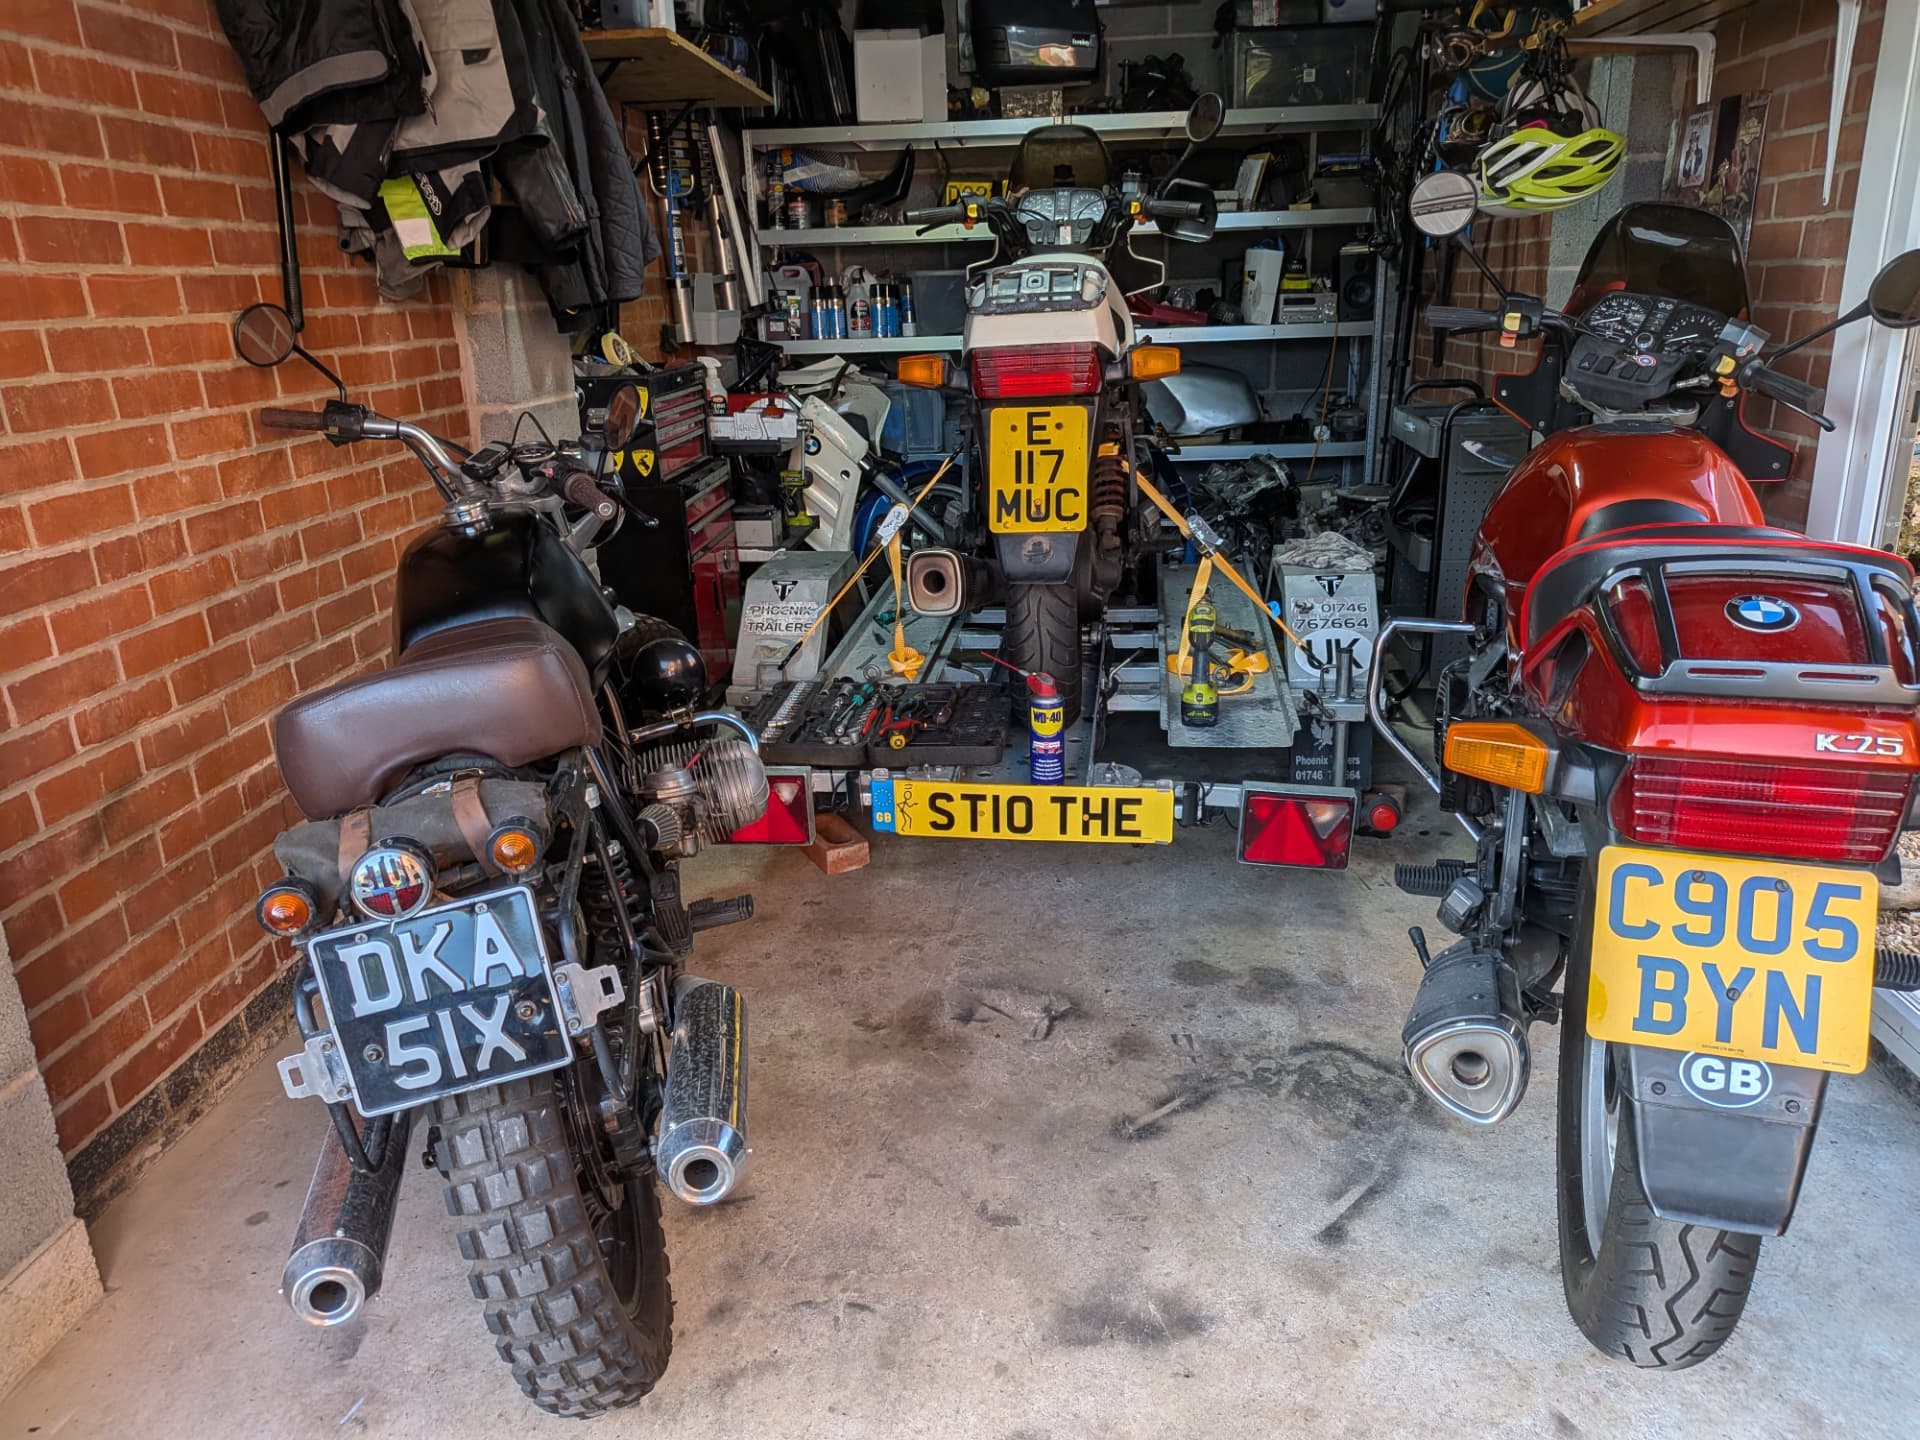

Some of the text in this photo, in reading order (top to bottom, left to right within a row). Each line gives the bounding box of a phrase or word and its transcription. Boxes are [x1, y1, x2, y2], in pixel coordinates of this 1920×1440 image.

[1026, 411, 1051, 445] E
[1014, 449, 1064, 484] 117
[996, 488, 1080, 522] MUC
[1295, 618, 1369, 630] 767664
[1321, 603, 1367, 613] 01746
[747, 622, 813, 633] TRAILERS
[1295, 755, 1328, 765] Phoenix
[1295, 770, 1323, 780] 01746
[876, 812, 892, 823] GB
[1050, 796, 1143, 837] THE
[1608, 863, 1862, 963] C905
[335, 911, 525, 1018] DKA
[1632, 954, 1822, 1055] BYN
[385, 994, 527, 1090] 51X
[1690, 1057, 1762, 1096] GB
